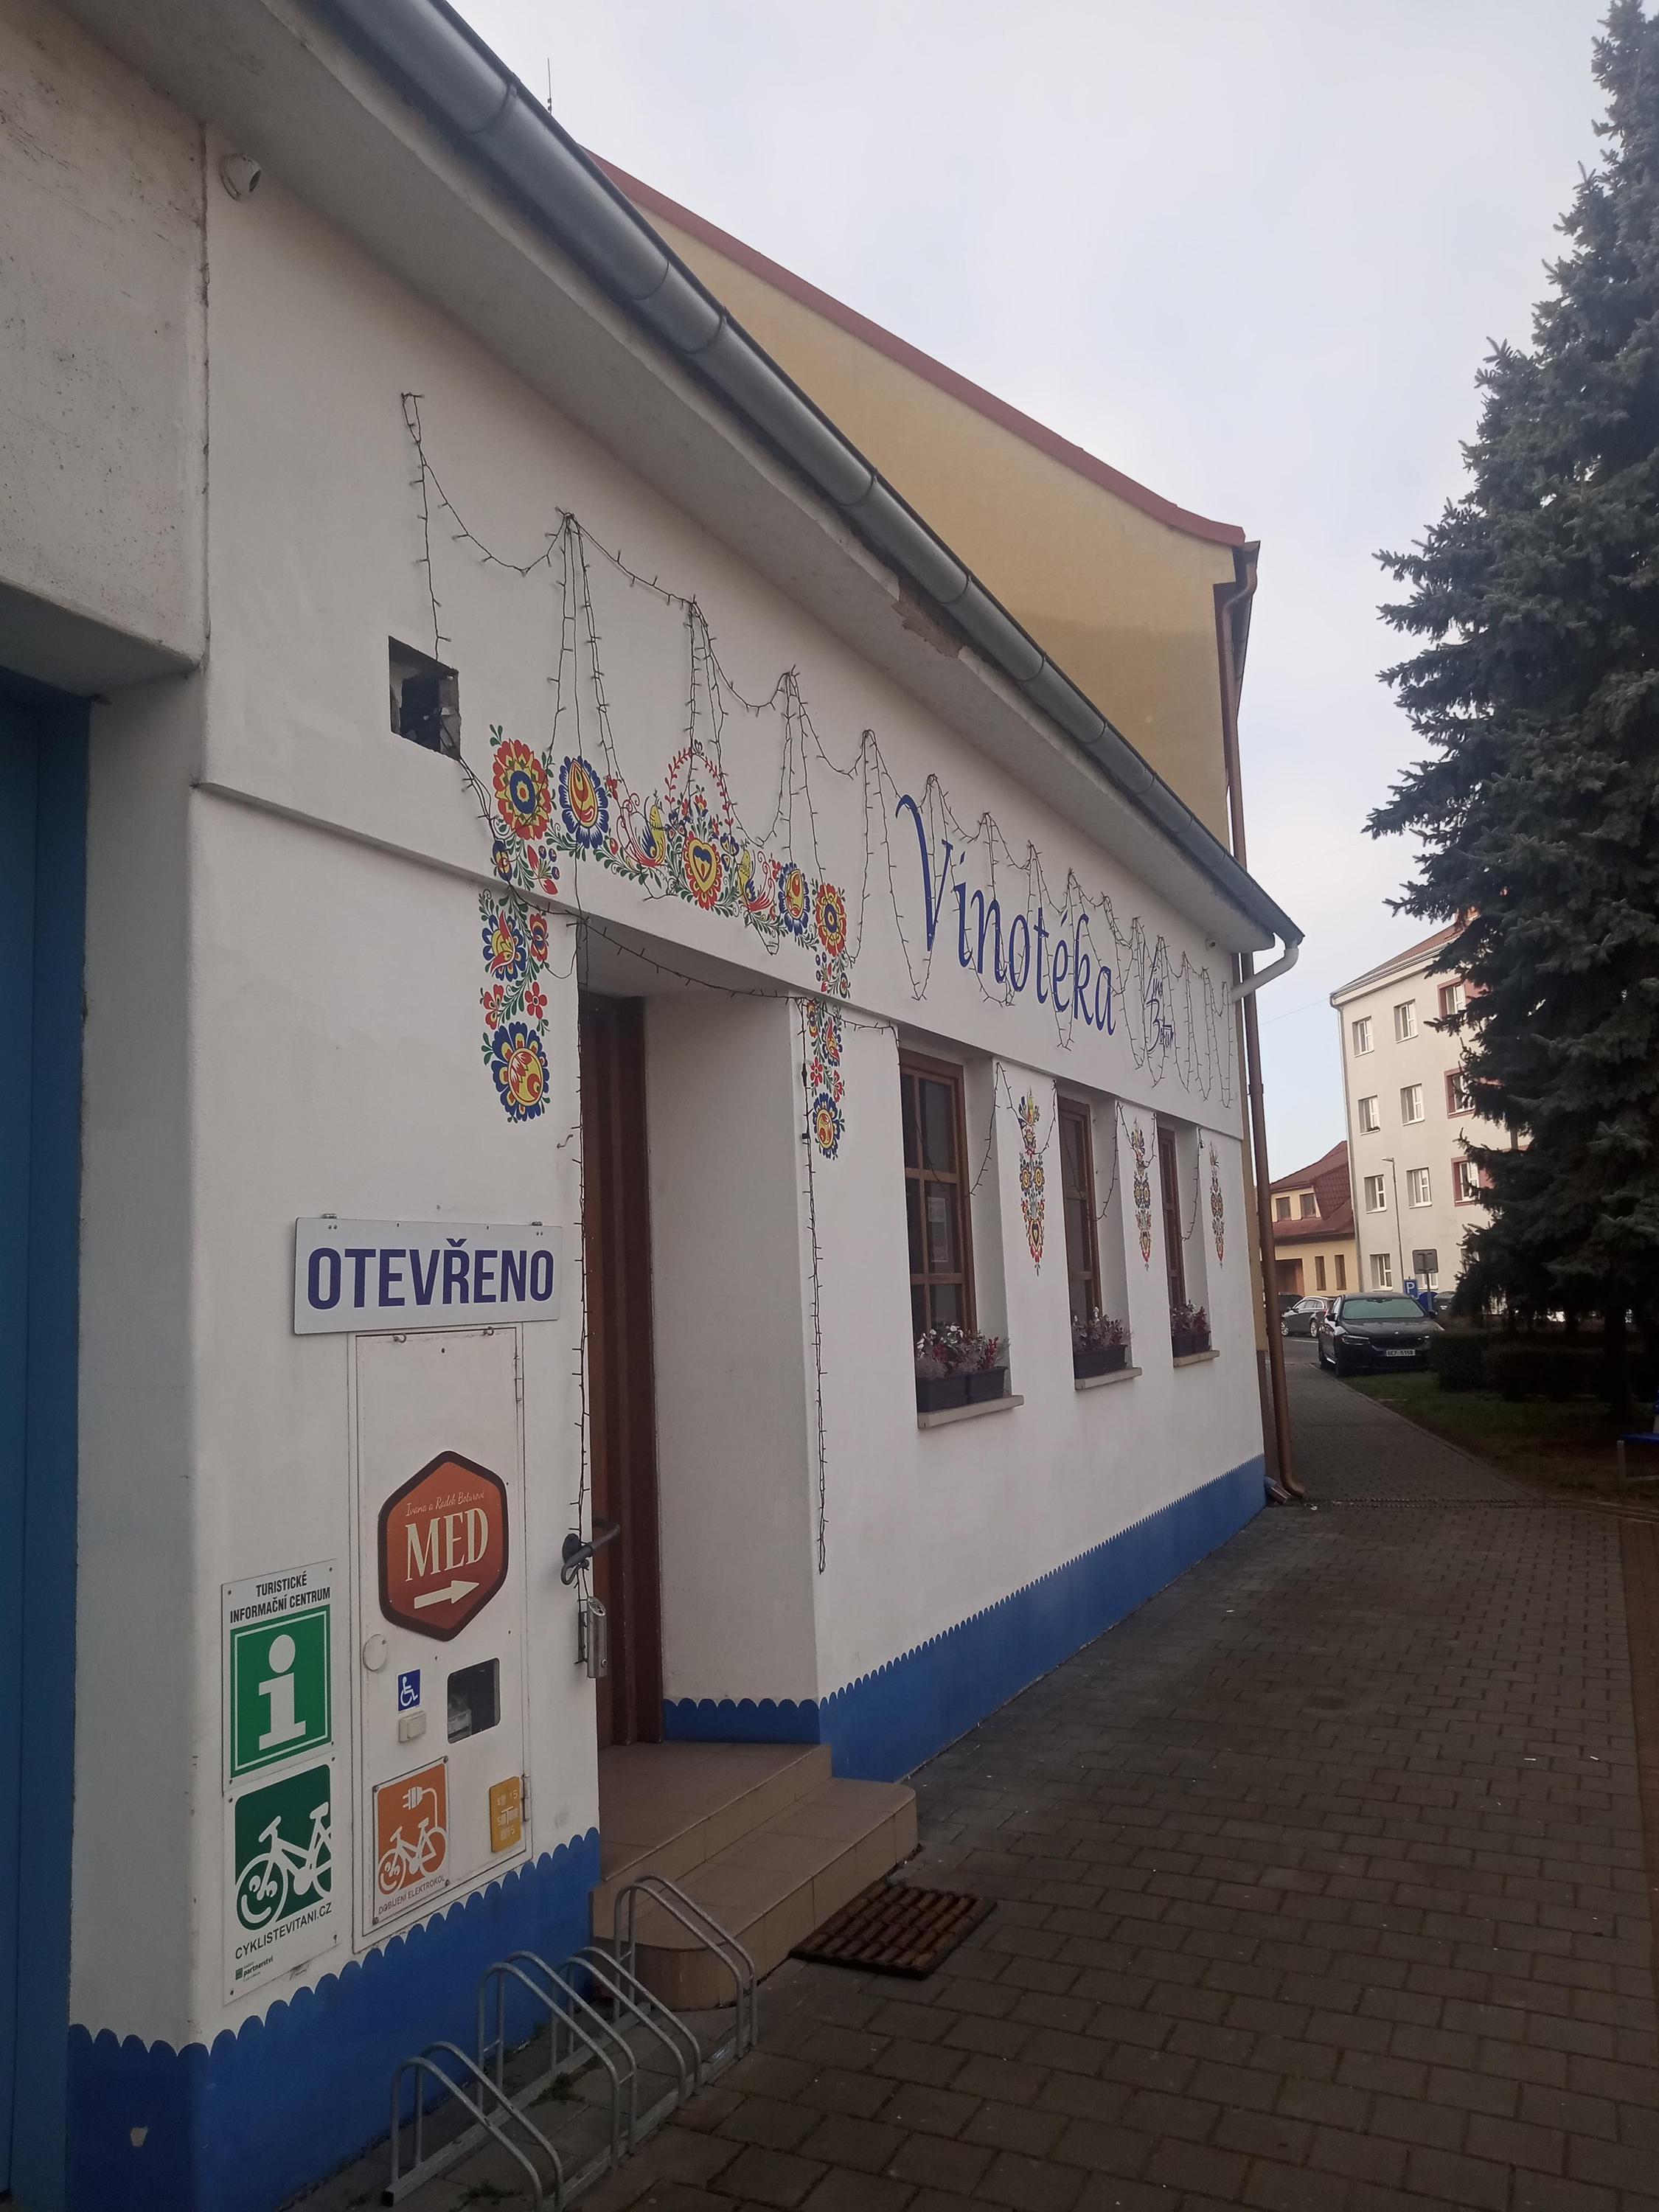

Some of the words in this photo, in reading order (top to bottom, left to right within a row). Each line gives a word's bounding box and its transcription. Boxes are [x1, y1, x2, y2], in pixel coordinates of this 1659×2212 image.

[307, 1237, 555, 1311] OTEVŘENO
[1406, 1281, 1415, 1294] P
[406, 1502, 427, 1517] Ivana
[435, 1492, 456, 1511] Radek
[404, 1507, 489, 1582] MED
[255, 1570, 308, 1598] TURISTICKÉ
[229, 1593, 288, 1624] INFORMAČNÍ
[289, 1586, 331, 1609] CENTRUM
[407, 1874, 445, 1900] ELEKTROKOL
[235, 1901, 333, 1960] CYKLISTEVITANI.CZ
